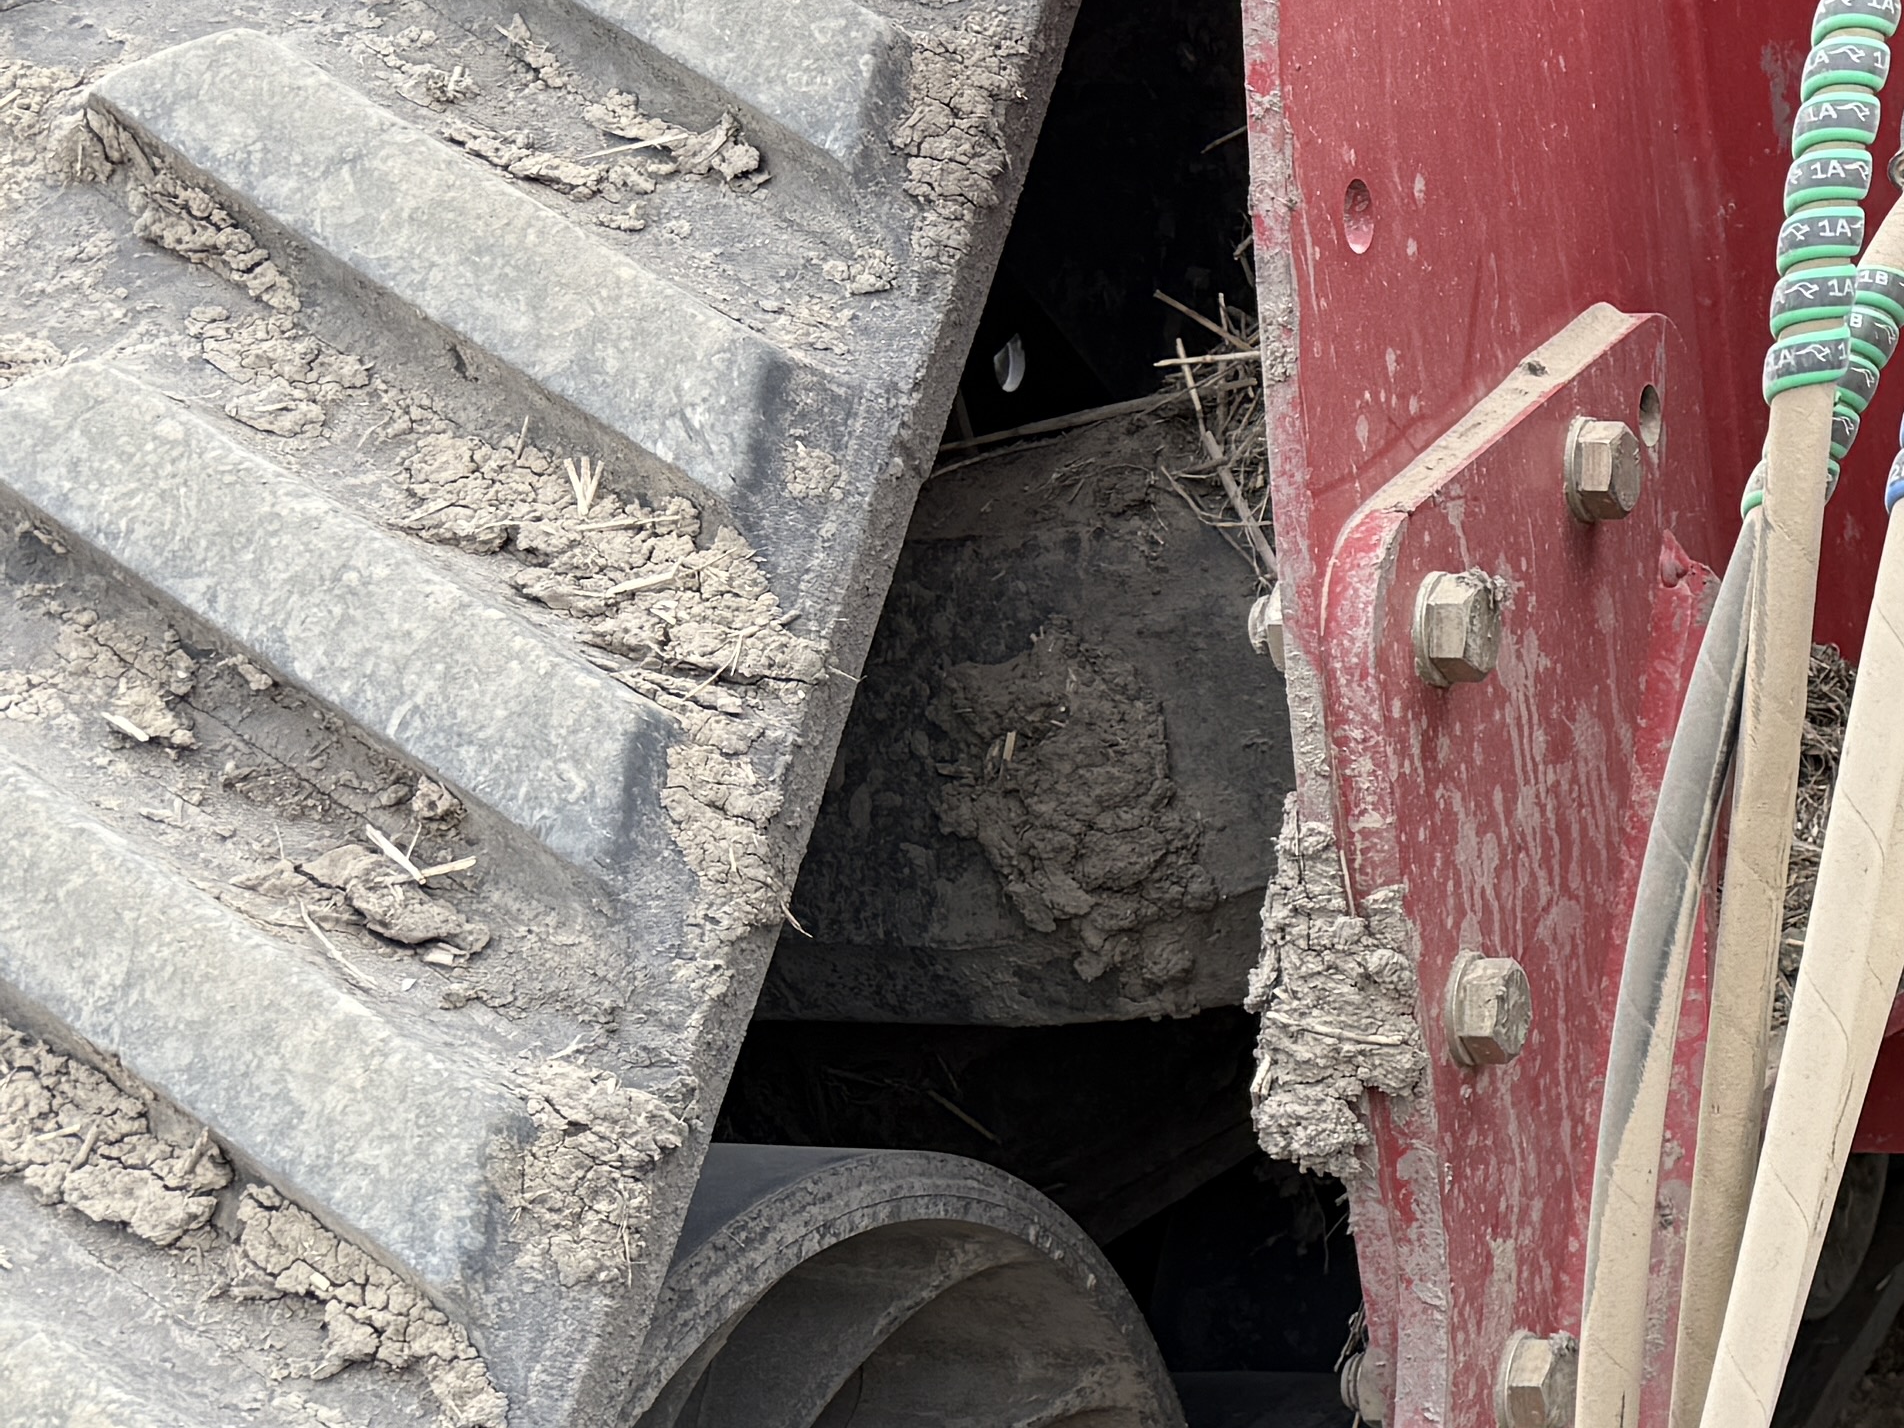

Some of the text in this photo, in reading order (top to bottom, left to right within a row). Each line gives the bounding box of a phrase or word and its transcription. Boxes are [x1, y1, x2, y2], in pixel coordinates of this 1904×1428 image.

[1808, 102, 1837, 122] 1A
[1811, 159, 1846, 180] 1A
[1818, 218, 1852, 237] 1A
[1858, 269, 1889, 286] 1B
[1828, 278, 1856, 297] 1A
